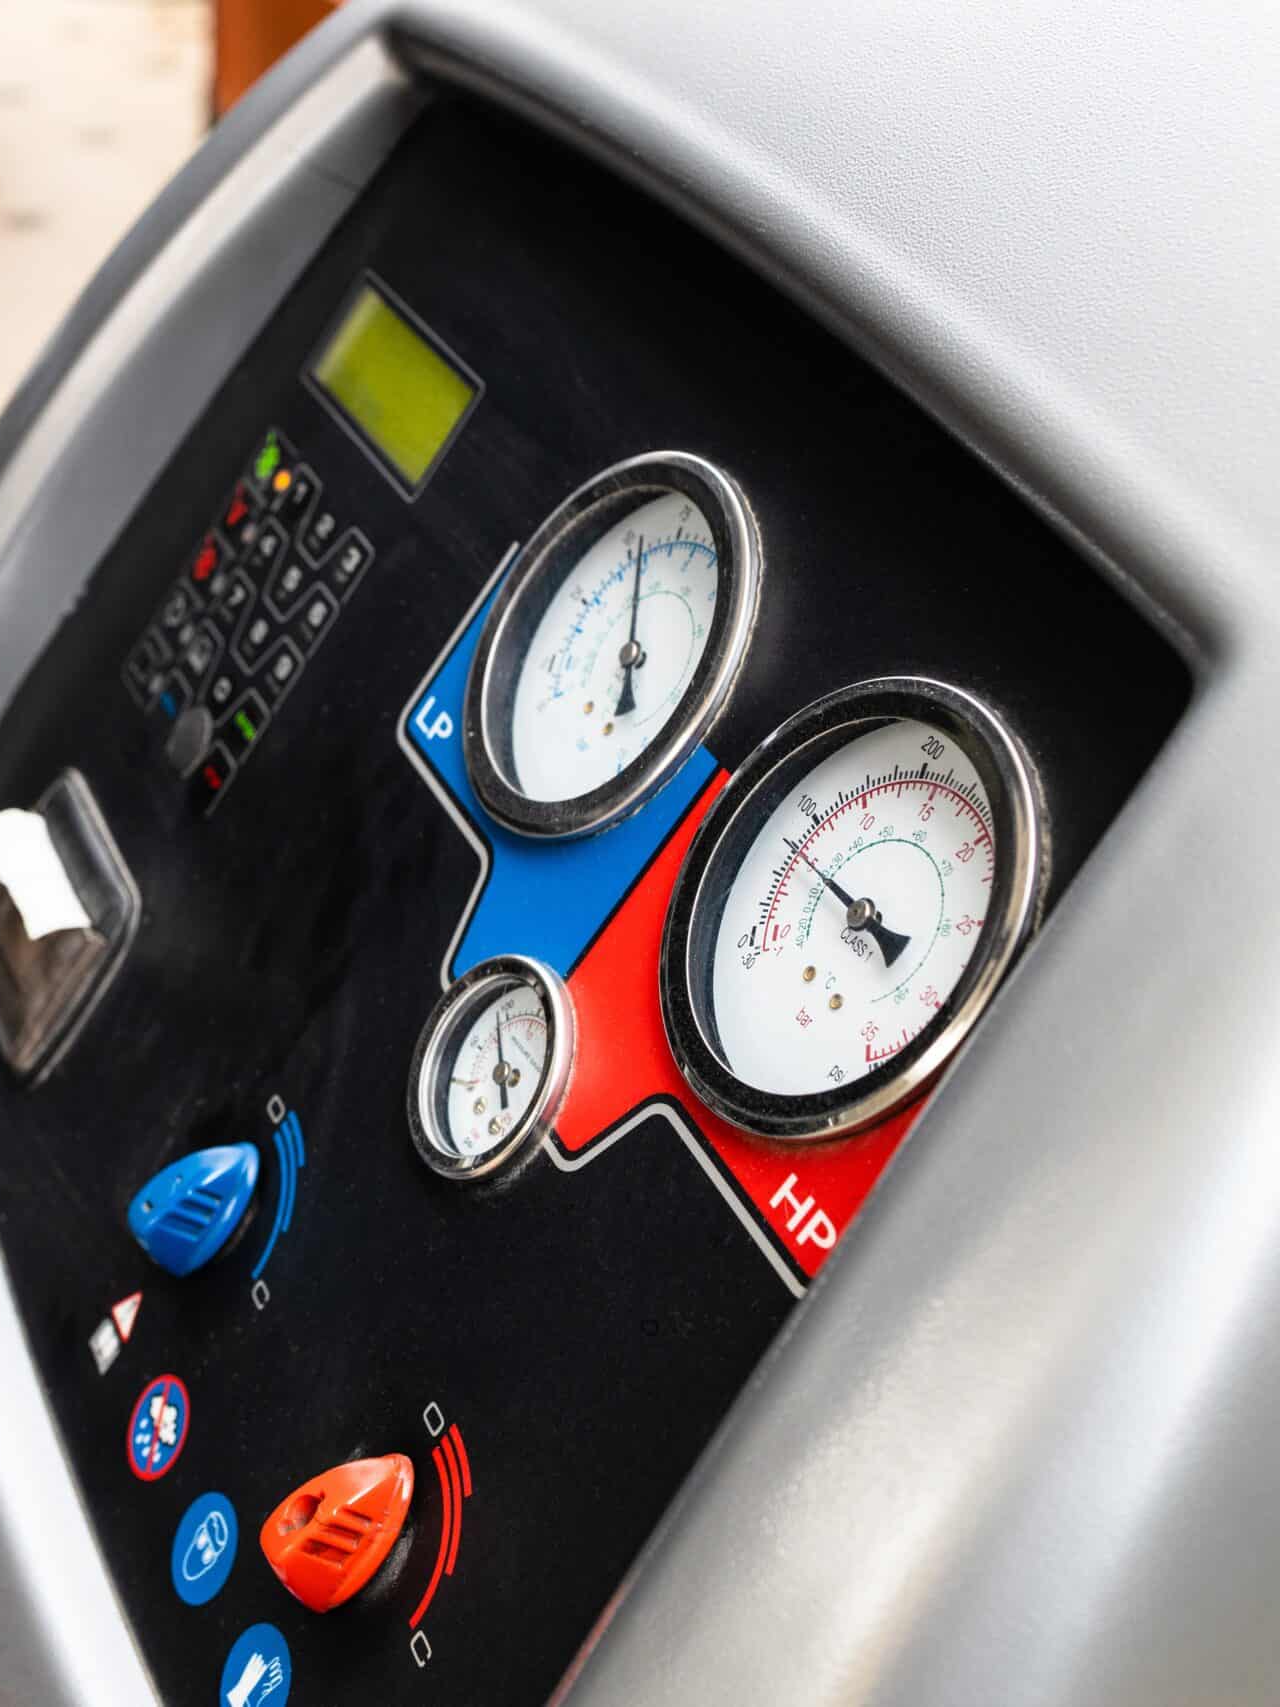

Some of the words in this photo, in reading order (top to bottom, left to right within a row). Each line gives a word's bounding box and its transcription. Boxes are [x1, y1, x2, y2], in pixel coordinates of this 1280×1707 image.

[415, 695, 453, 739] LP
[921, 735, 945, 760] 200
[797, 794, 816, 816] 100
[918, 802, 935, 822] 15
[859, 812, 875, 831] 10
[955, 841, 976, 863] 20
[780, 924, 791, 938] 0
[955, 914, 976, 936] 25
[737, 934, 749, 948] 0
[840, 927, 868, 957] CLASS
[919, 985, 938, 1007] 30
[795, 1008, 813, 1028] bar
[861, 1021, 880, 1042] 35
[768, 1172, 837, 1249] HP
